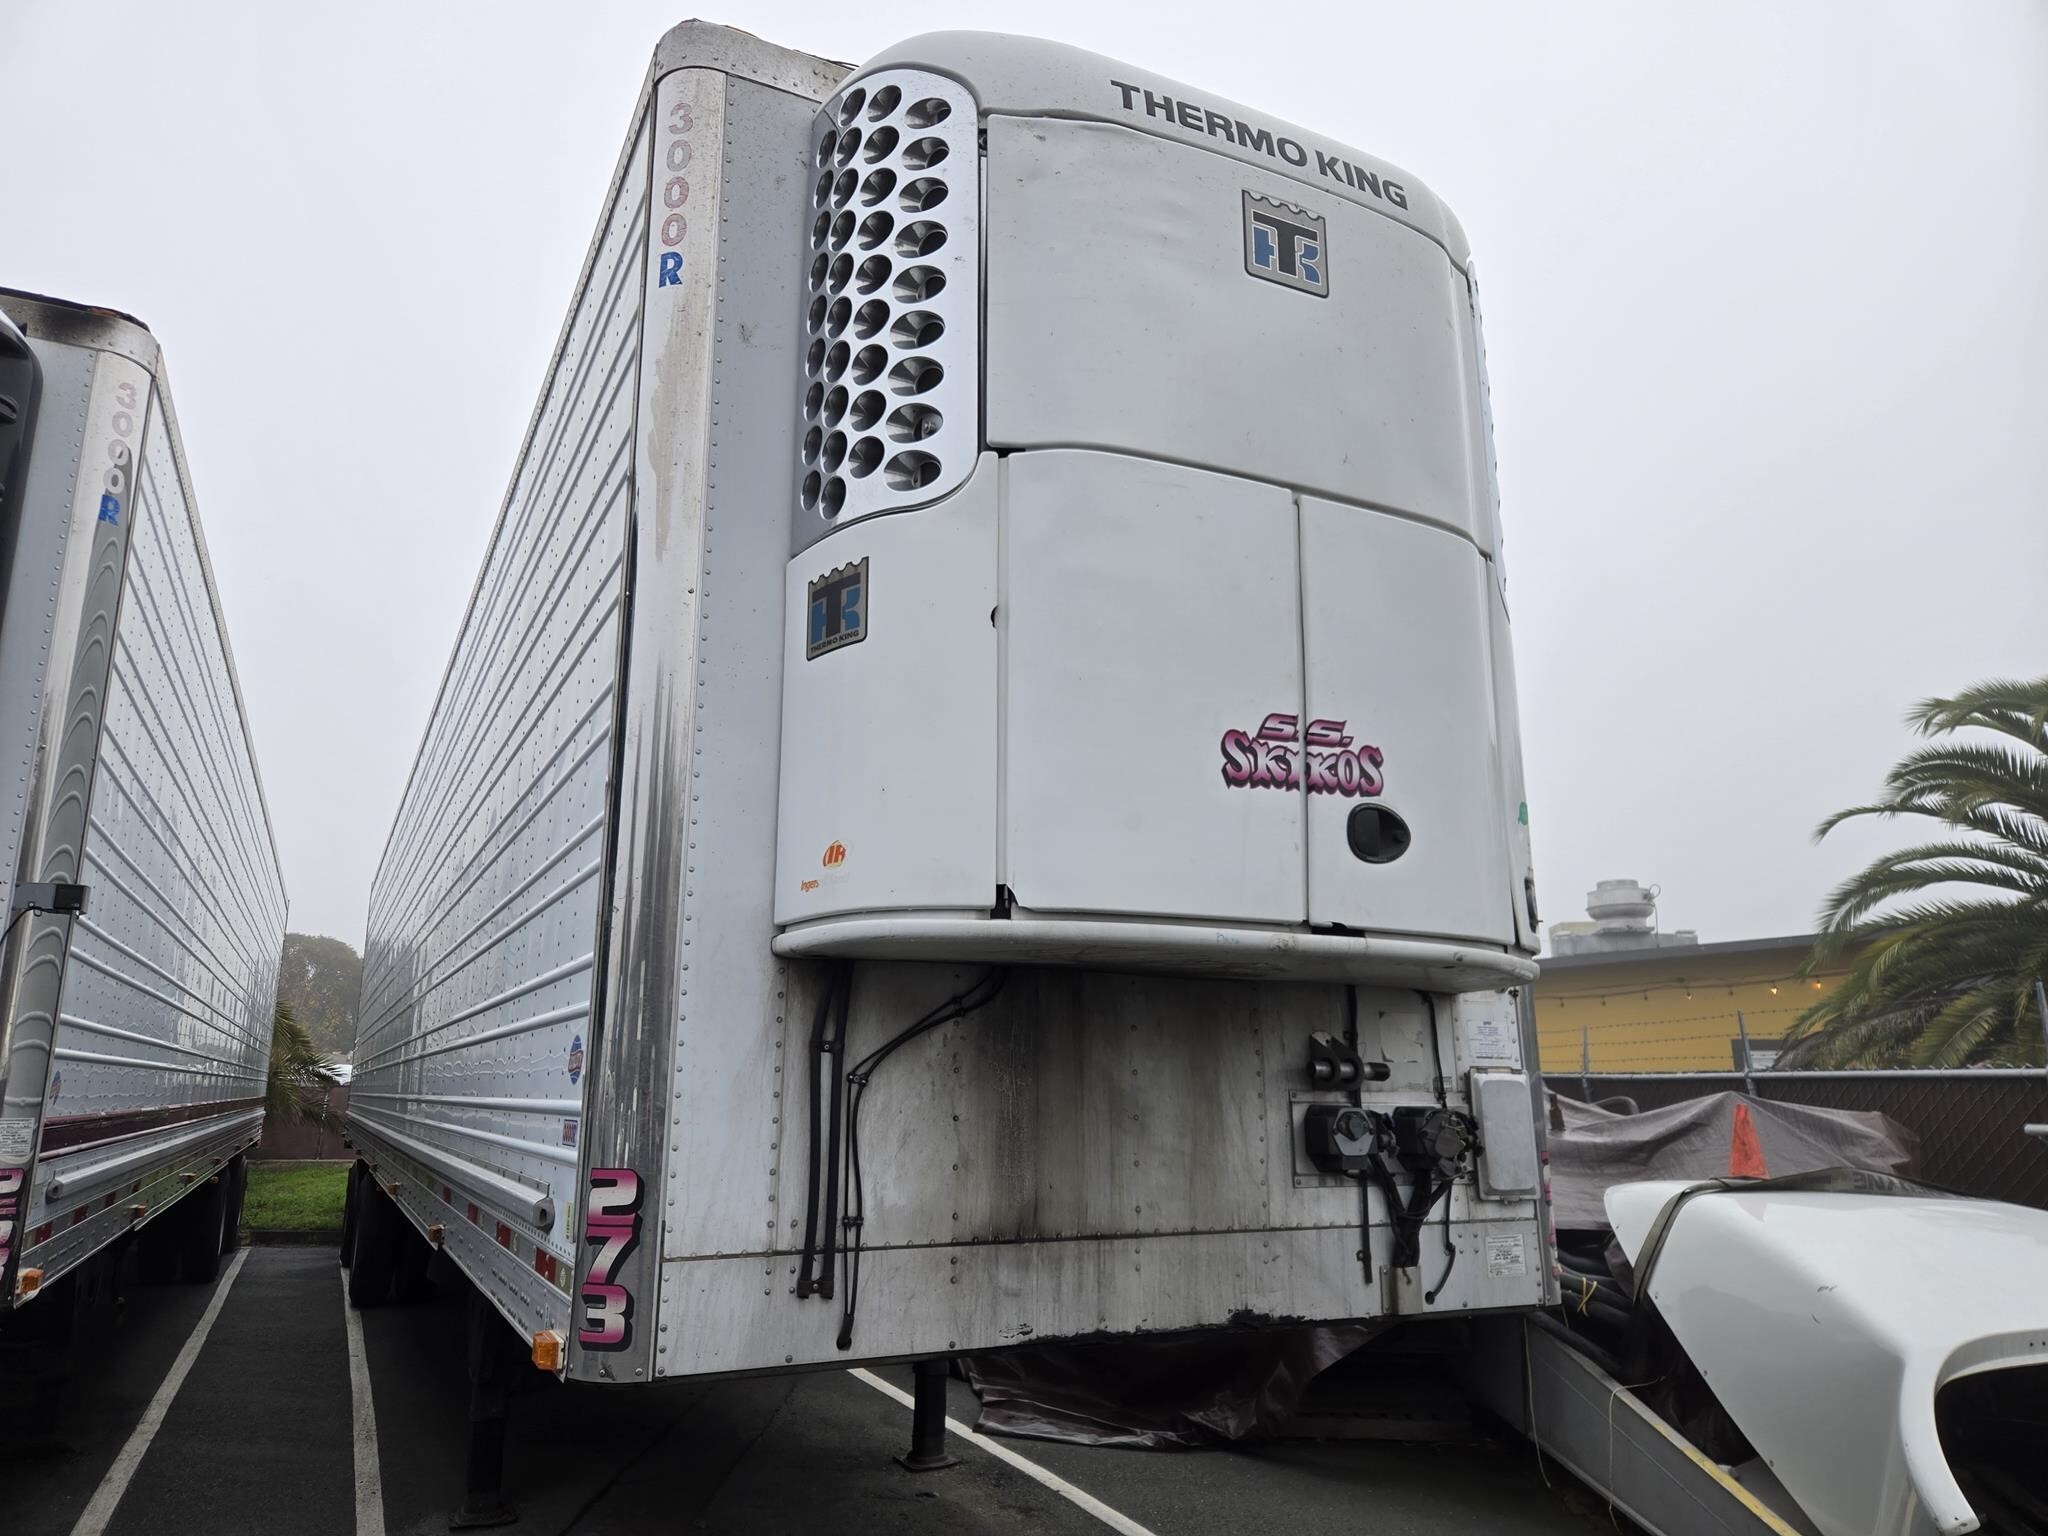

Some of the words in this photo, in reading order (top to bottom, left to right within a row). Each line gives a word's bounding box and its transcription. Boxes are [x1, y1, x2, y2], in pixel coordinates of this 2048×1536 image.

[1110, 79, 1308, 167] THERMO
[1315, 149, 1409, 210] KING
[810, 637, 838, 654] THERMO
[839, 629, 860, 642] KING
[578, 1167, 645, 1352] 273
